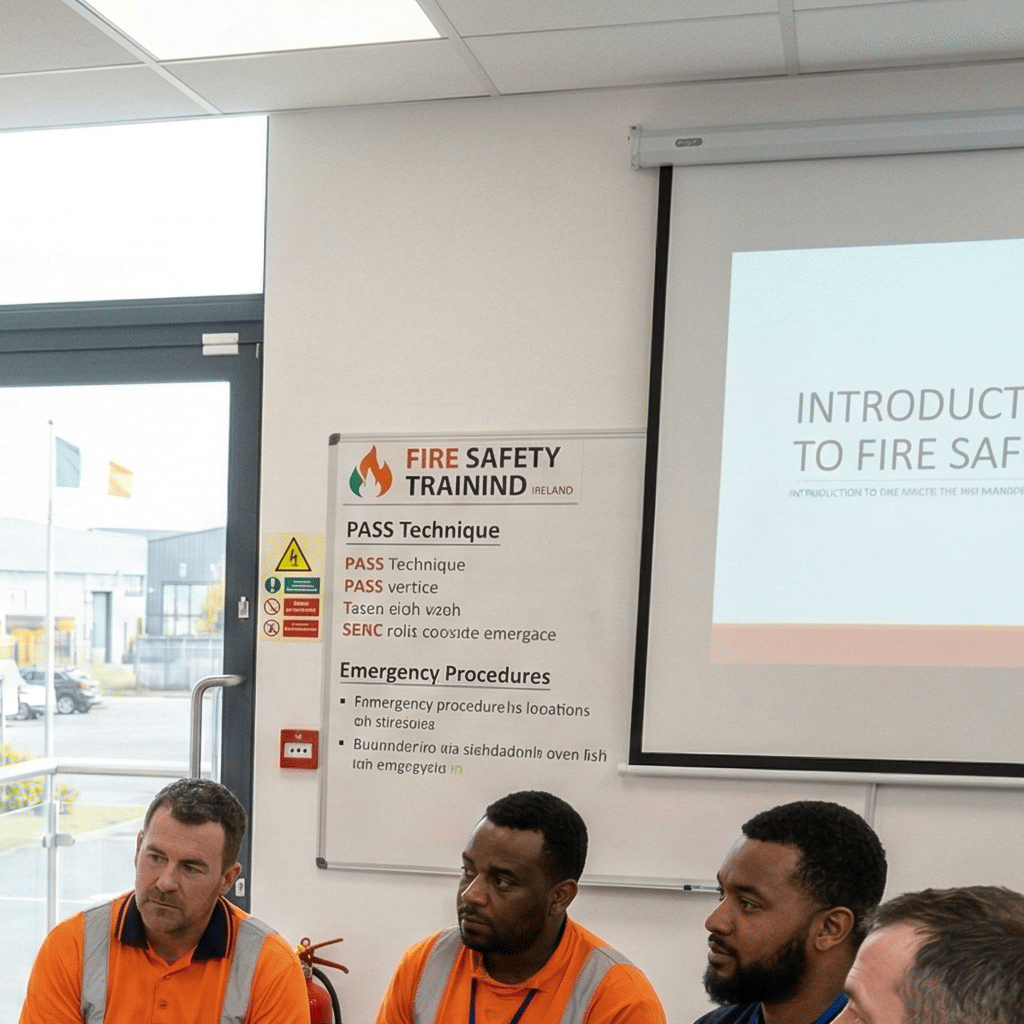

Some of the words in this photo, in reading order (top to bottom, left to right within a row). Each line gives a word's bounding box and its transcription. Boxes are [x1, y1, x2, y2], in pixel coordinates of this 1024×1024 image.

[797, 386, 1024, 423] INTRODUCT
[405, 447, 459, 470] FIRE
[465, 446, 561, 469] SAFETY
[793, 439, 843, 472] TO
[857, 437, 937, 471] FIRE
[949, 436, 1022, 470] SAF
[405, 474, 527, 497] TRAININD
[531, 485, 574, 495] IRELAND
[347, 521, 394, 538] PASS
[400, 520, 501, 543] Technique
[344, 556, 385, 571] PASS
[388, 556, 466, 575] Technique
[344, 578, 383, 594] PASS
[388, 580, 439, 595] vertice
[343, 600, 384, 616] Tasen
[342, 622, 383, 637] SENC
[483, 627, 557, 644] emergace
[339, 661, 440, 685] Emergency
[444, 665, 551, 685] Procedures
[546, 749, 580, 761] oven
